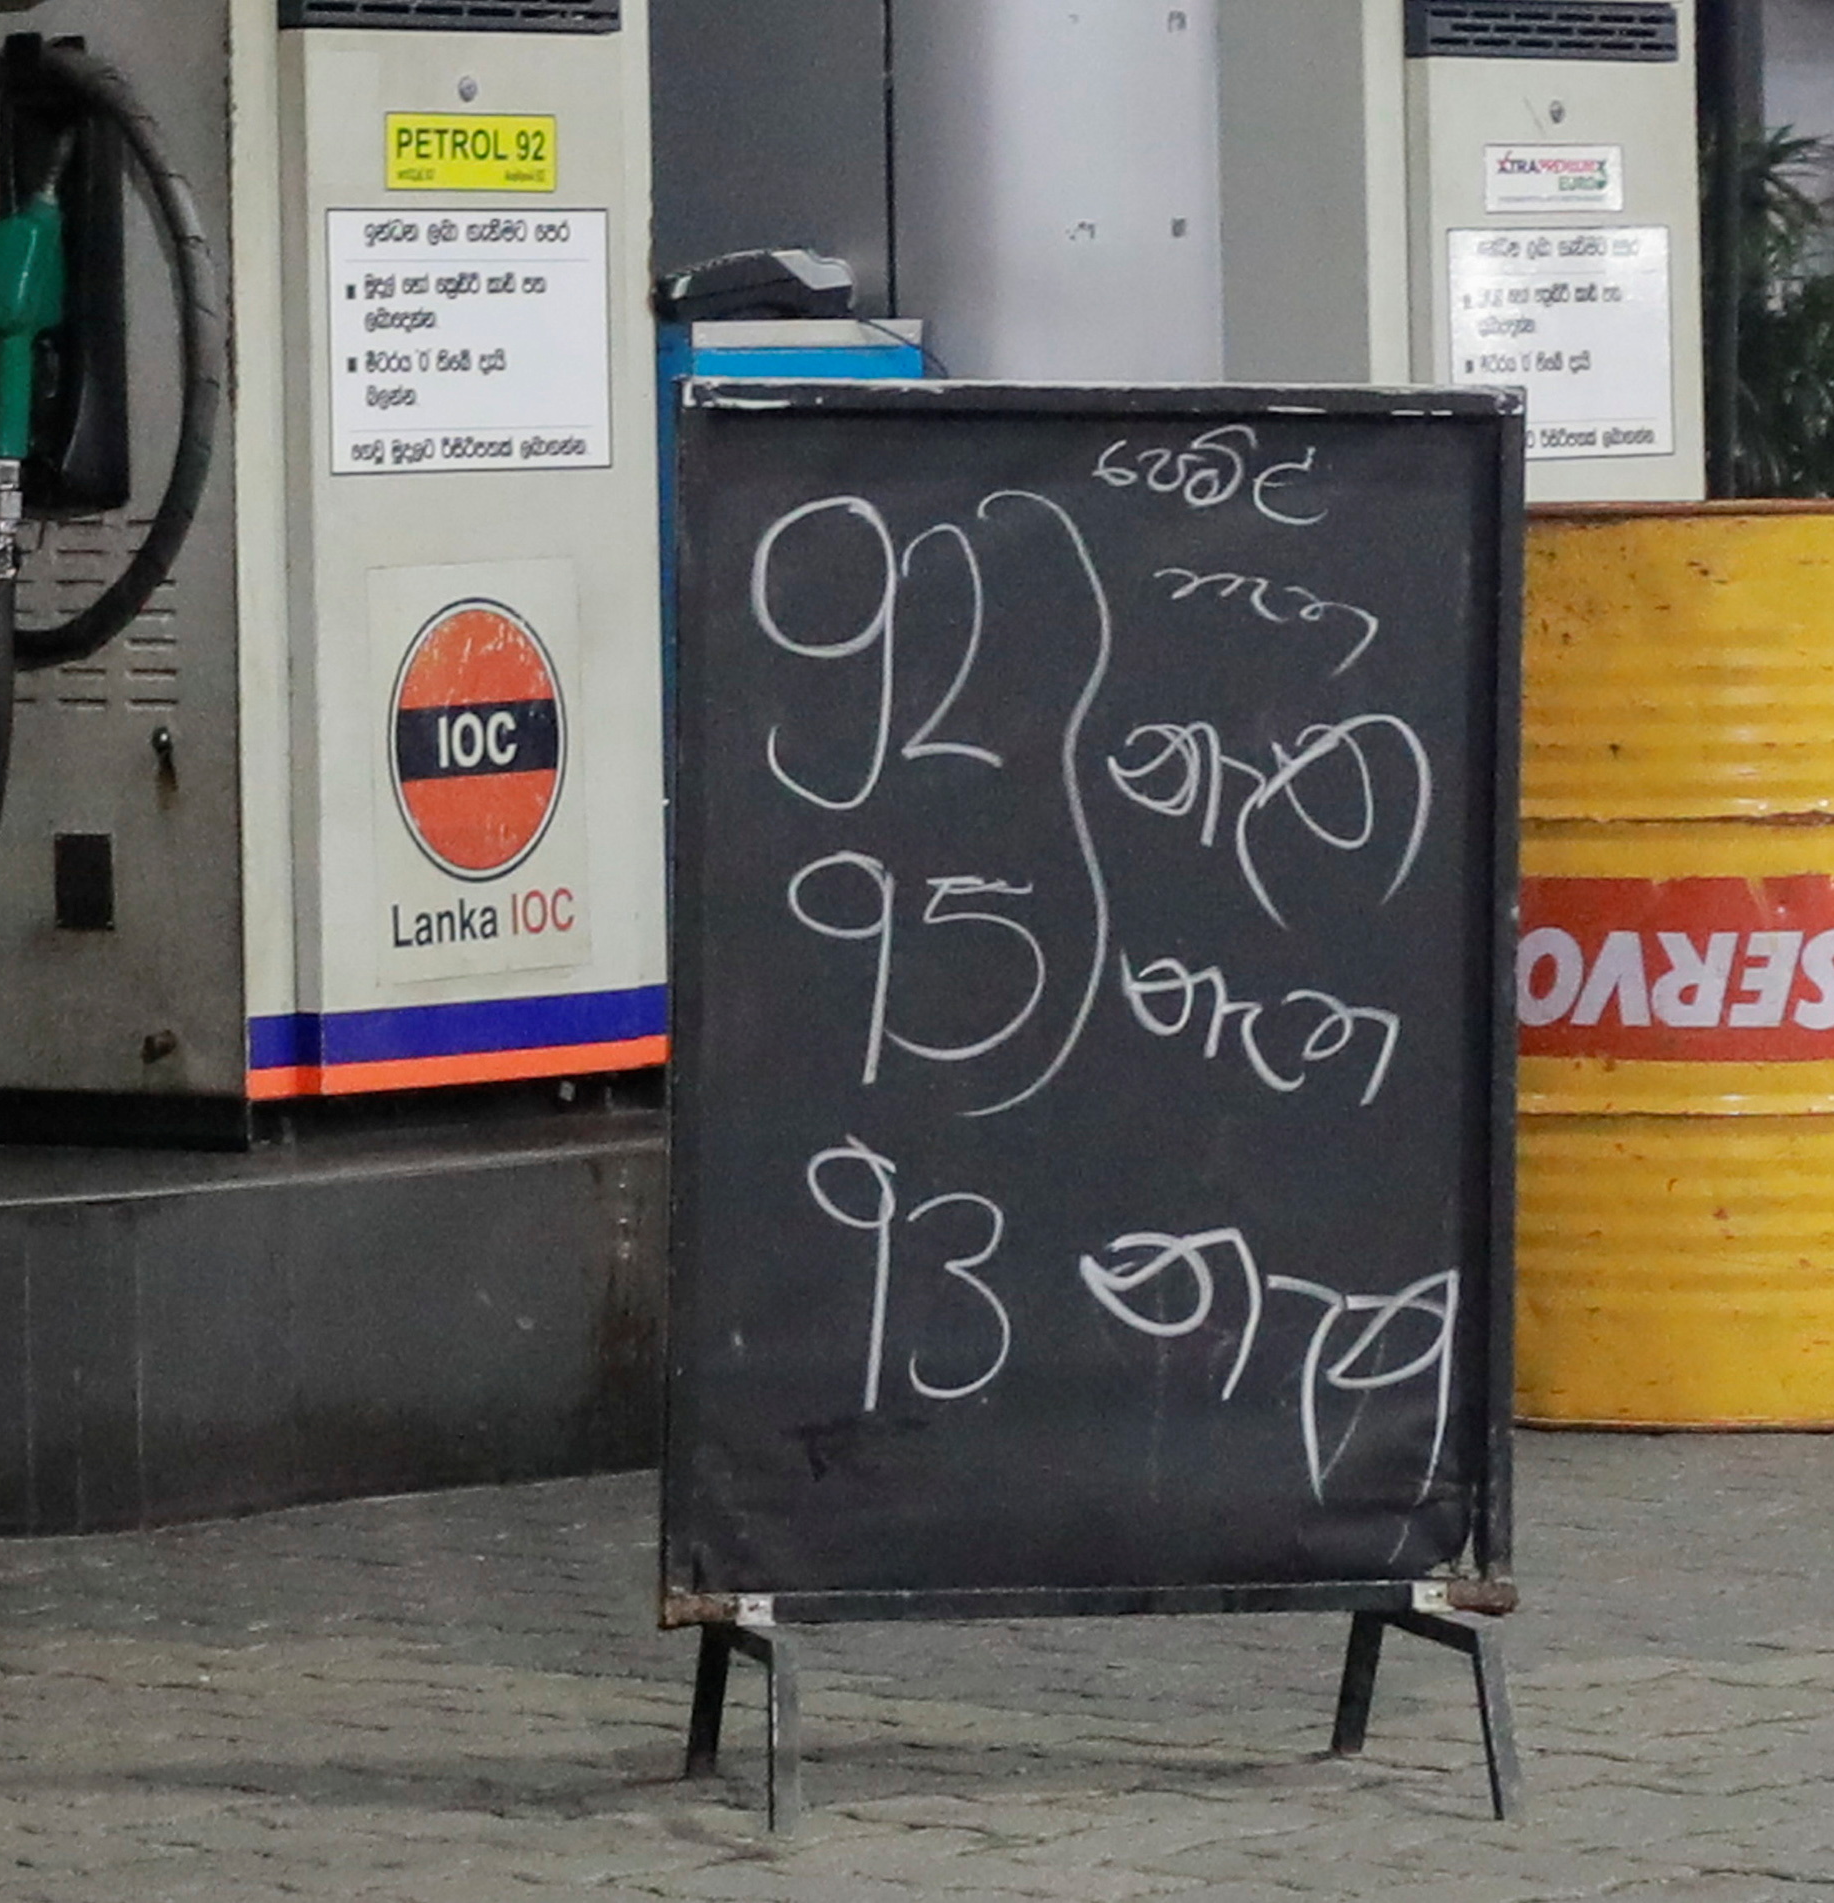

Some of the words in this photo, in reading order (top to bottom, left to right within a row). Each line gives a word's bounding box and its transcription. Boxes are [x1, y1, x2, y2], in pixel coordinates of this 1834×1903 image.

[396, 128, 507, 161] PETROL
[516, 131, 546, 161] 92
[750, 494, 1002, 811] 92
[437, 710, 518, 769] IOC
[391, 898, 500, 949] Lanka
[511, 886, 575, 936] IOC
[787, 849, 1047, 1086] 95
[805, 1132, 1012, 1411] 93
